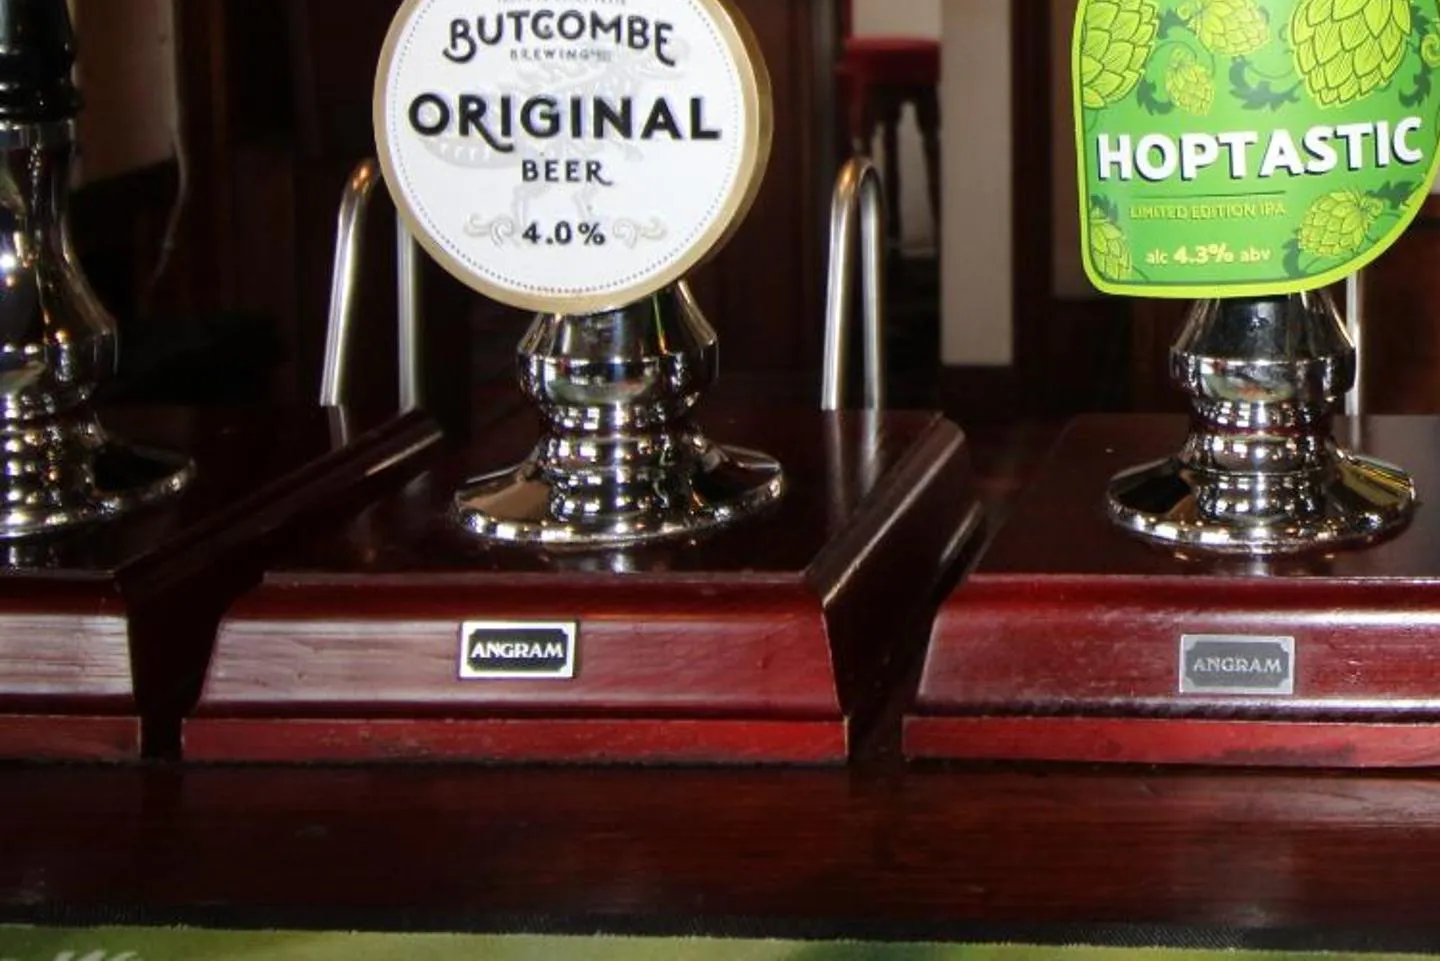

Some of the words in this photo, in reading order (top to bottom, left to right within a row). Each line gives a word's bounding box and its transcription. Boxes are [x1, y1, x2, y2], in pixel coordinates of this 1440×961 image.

[442, 8, 677, 67] BUTCOMBE
[509, 47, 590, 61] BREWING
[407, 91, 722, 153] ORIGINAL
[1096, 115, 1425, 183] HOPTASTIC
[521, 158, 614, 186] BEER
[1129, 204, 1188, 220] LIMITED
[1190, 202, 1256, 220] EDITION
[1260, 200, 1287, 218] IPA
[521, 220, 606, 246] 4.0%
[1144, 248, 1169, 266] alc
[1173, 241, 1235, 265] 4.3%
[1239, 246, 1272, 264] abv
[470, 641, 565, 659] ANGRAM
[1192, 656, 1282, 674] ANGRAM
